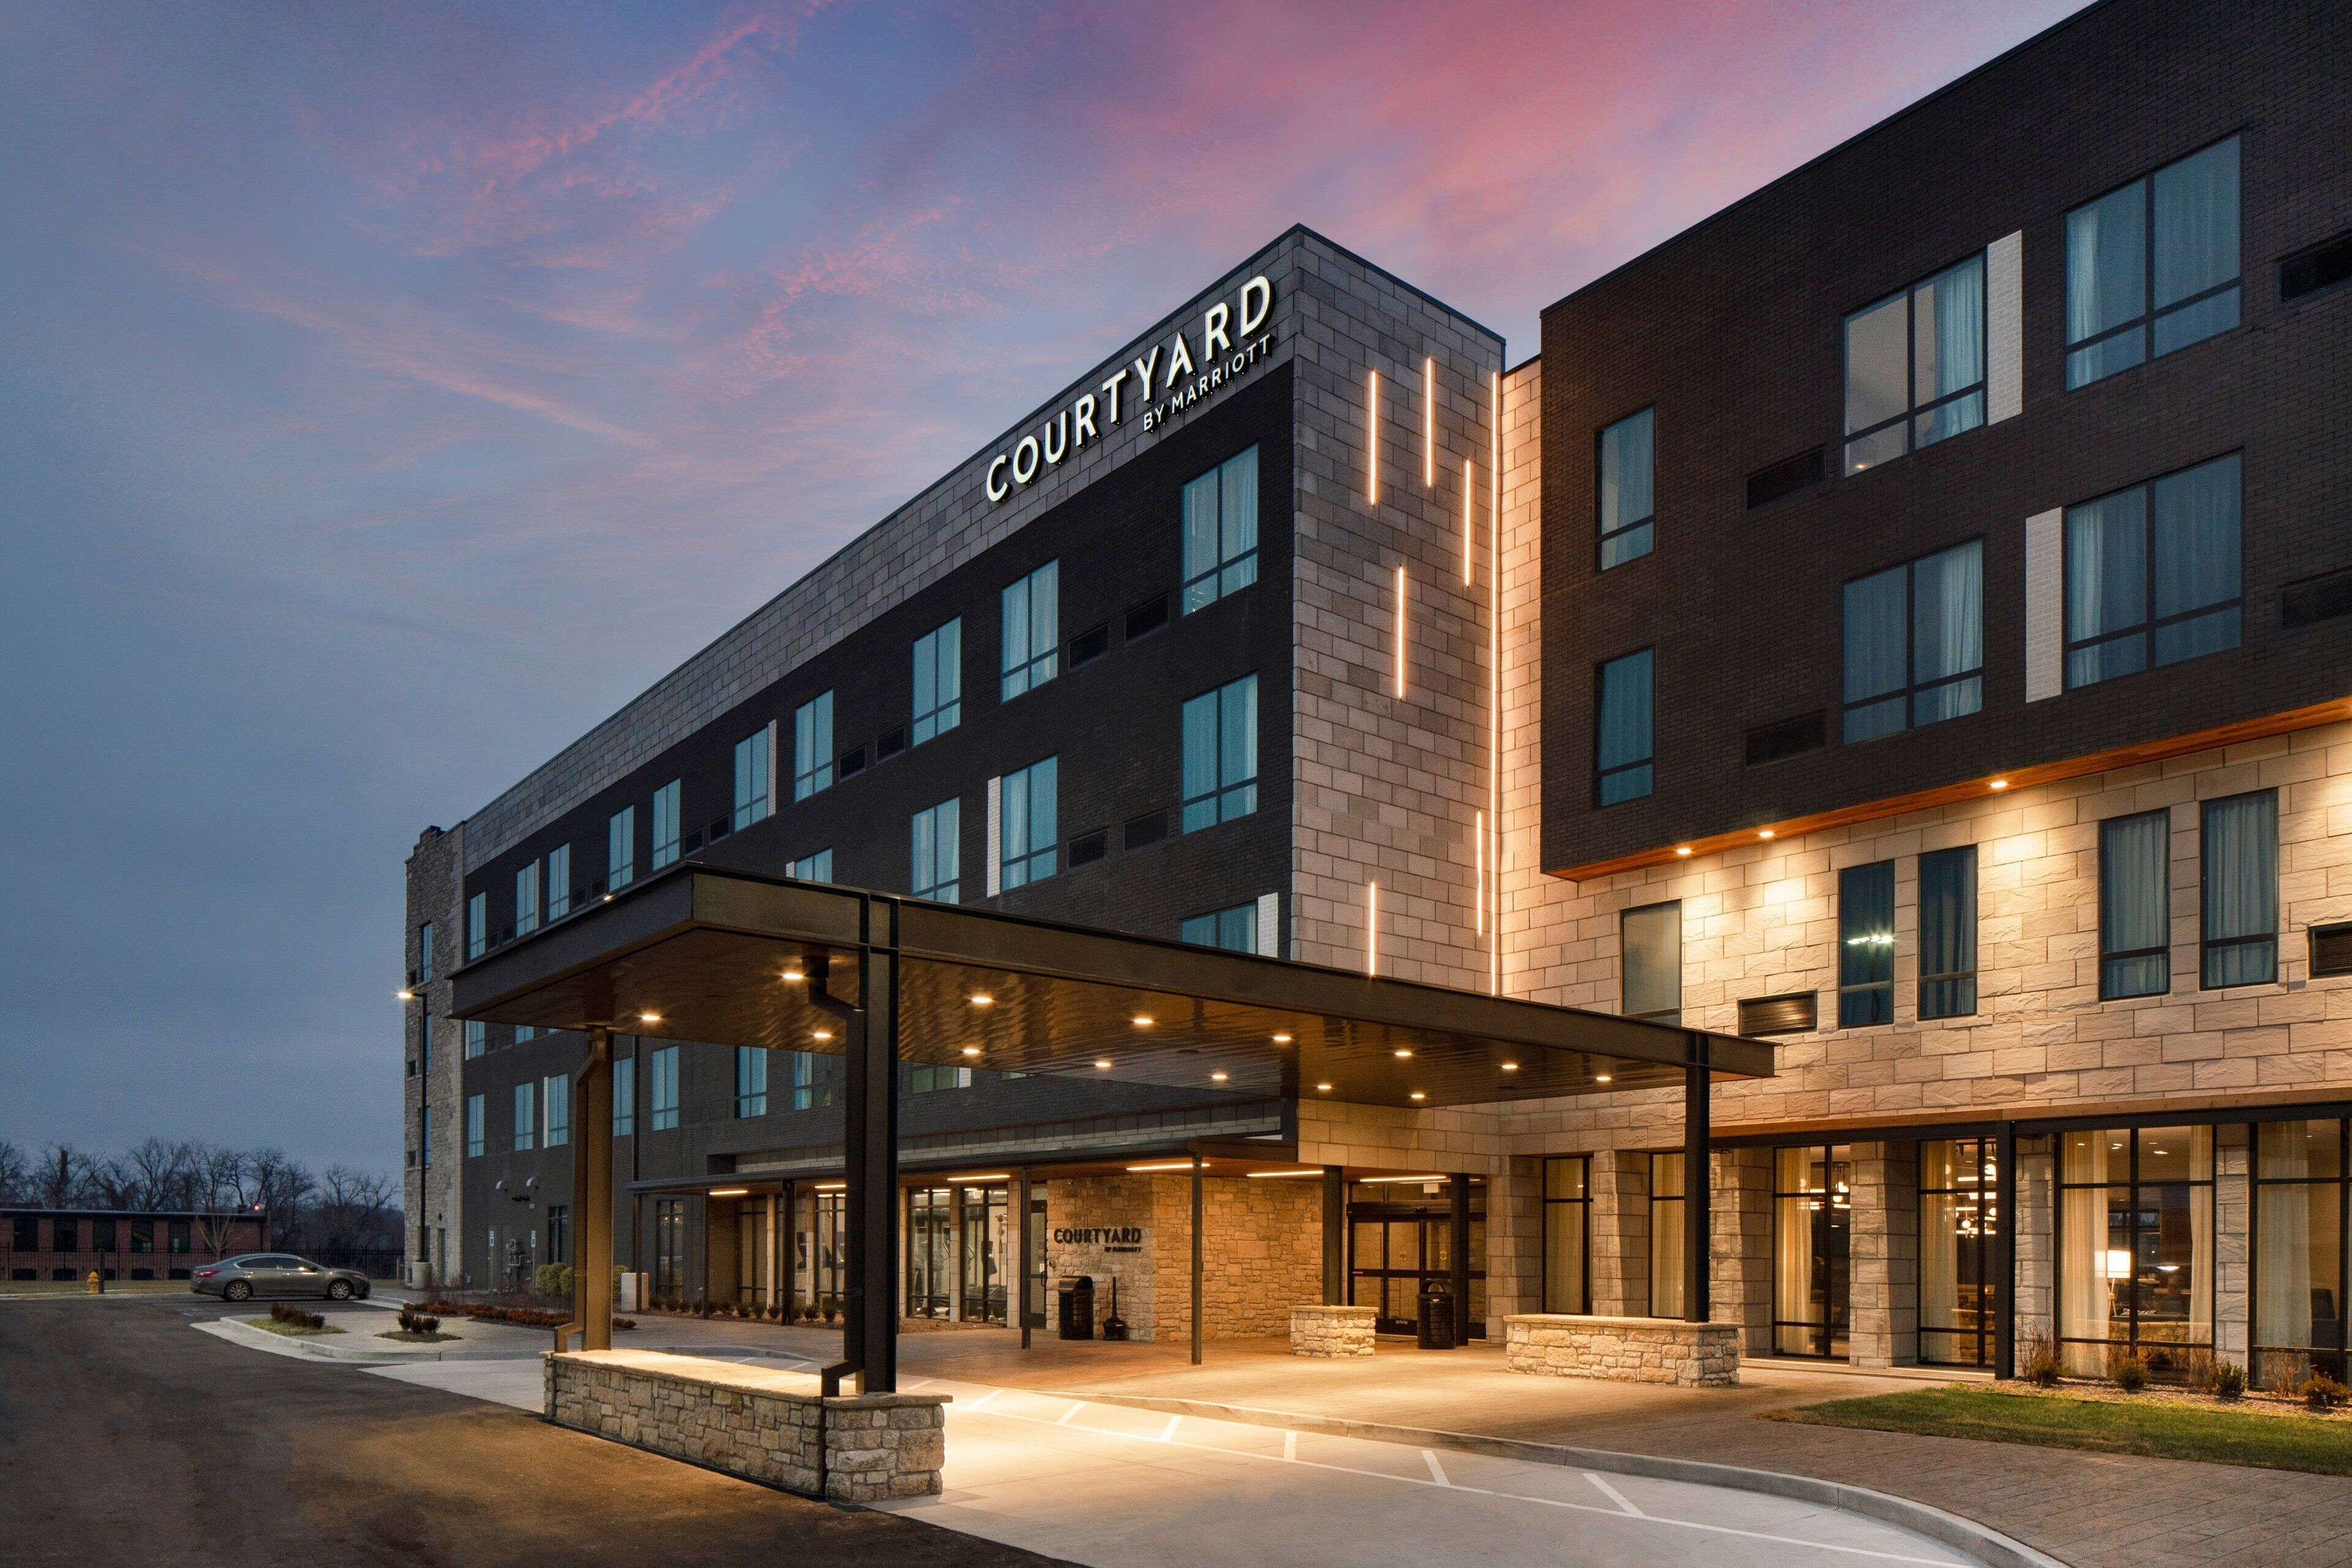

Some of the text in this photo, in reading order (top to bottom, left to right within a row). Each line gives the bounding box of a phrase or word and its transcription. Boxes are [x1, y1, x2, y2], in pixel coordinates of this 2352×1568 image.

[986, 276, 1273, 502] COURTYARD
[1144, 333, 1272, 432] BY MARRIOTT
[1054, 1227, 1141, 1243] COURTYARD
